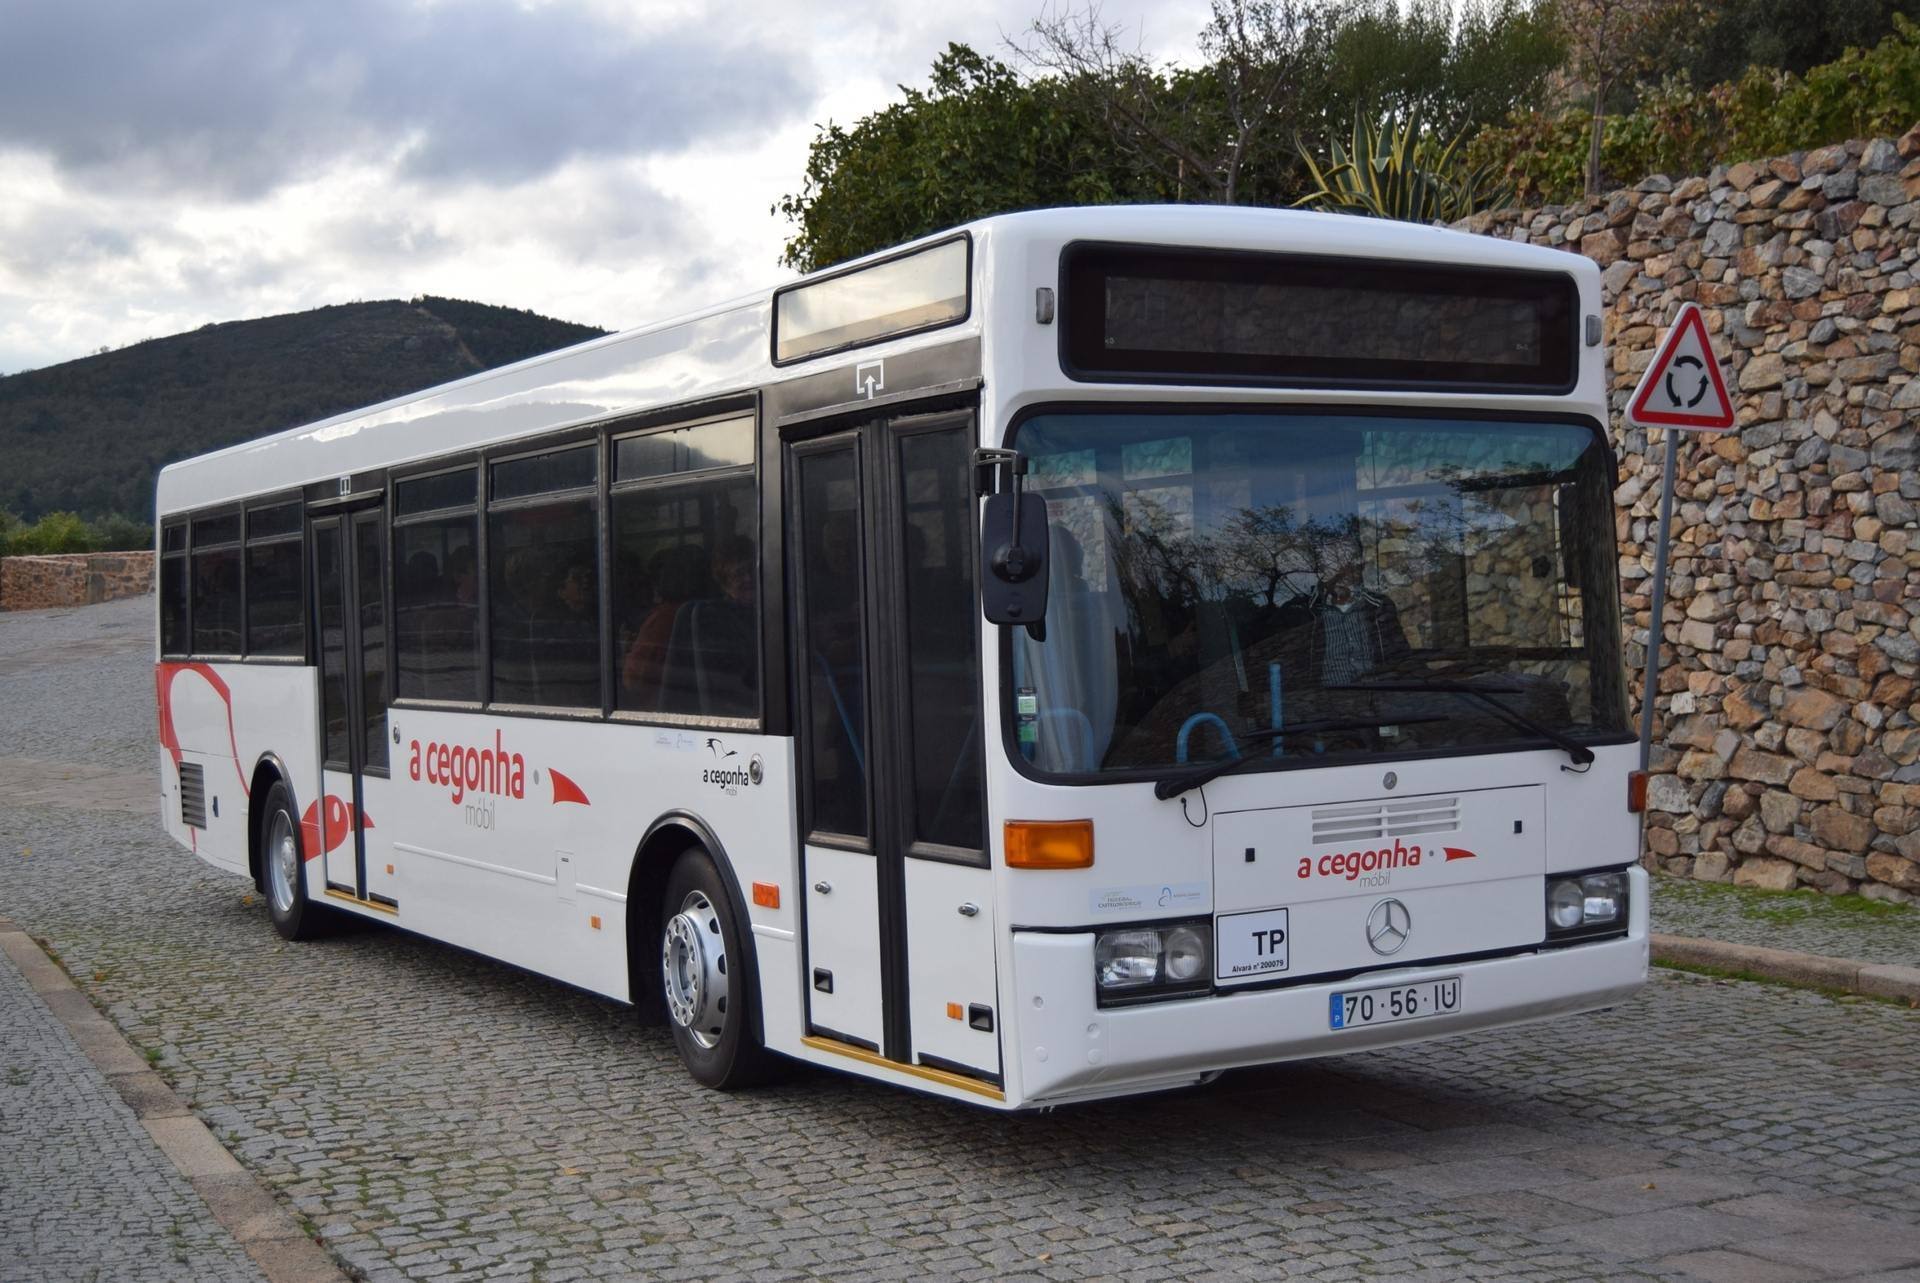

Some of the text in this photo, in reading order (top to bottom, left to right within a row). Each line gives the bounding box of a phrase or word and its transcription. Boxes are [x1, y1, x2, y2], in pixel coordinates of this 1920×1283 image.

[409, 728, 525, 805] a cegonha
[703, 765, 749, 789] a cegonha
[465, 797, 495, 831] móbil
[1297, 838, 1422, 881] a cegonha
[1359, 872, 1391, 888] móbil
[1252, 929, 1285, 956] TP
[1260, 960, 1285, 969] 200079
